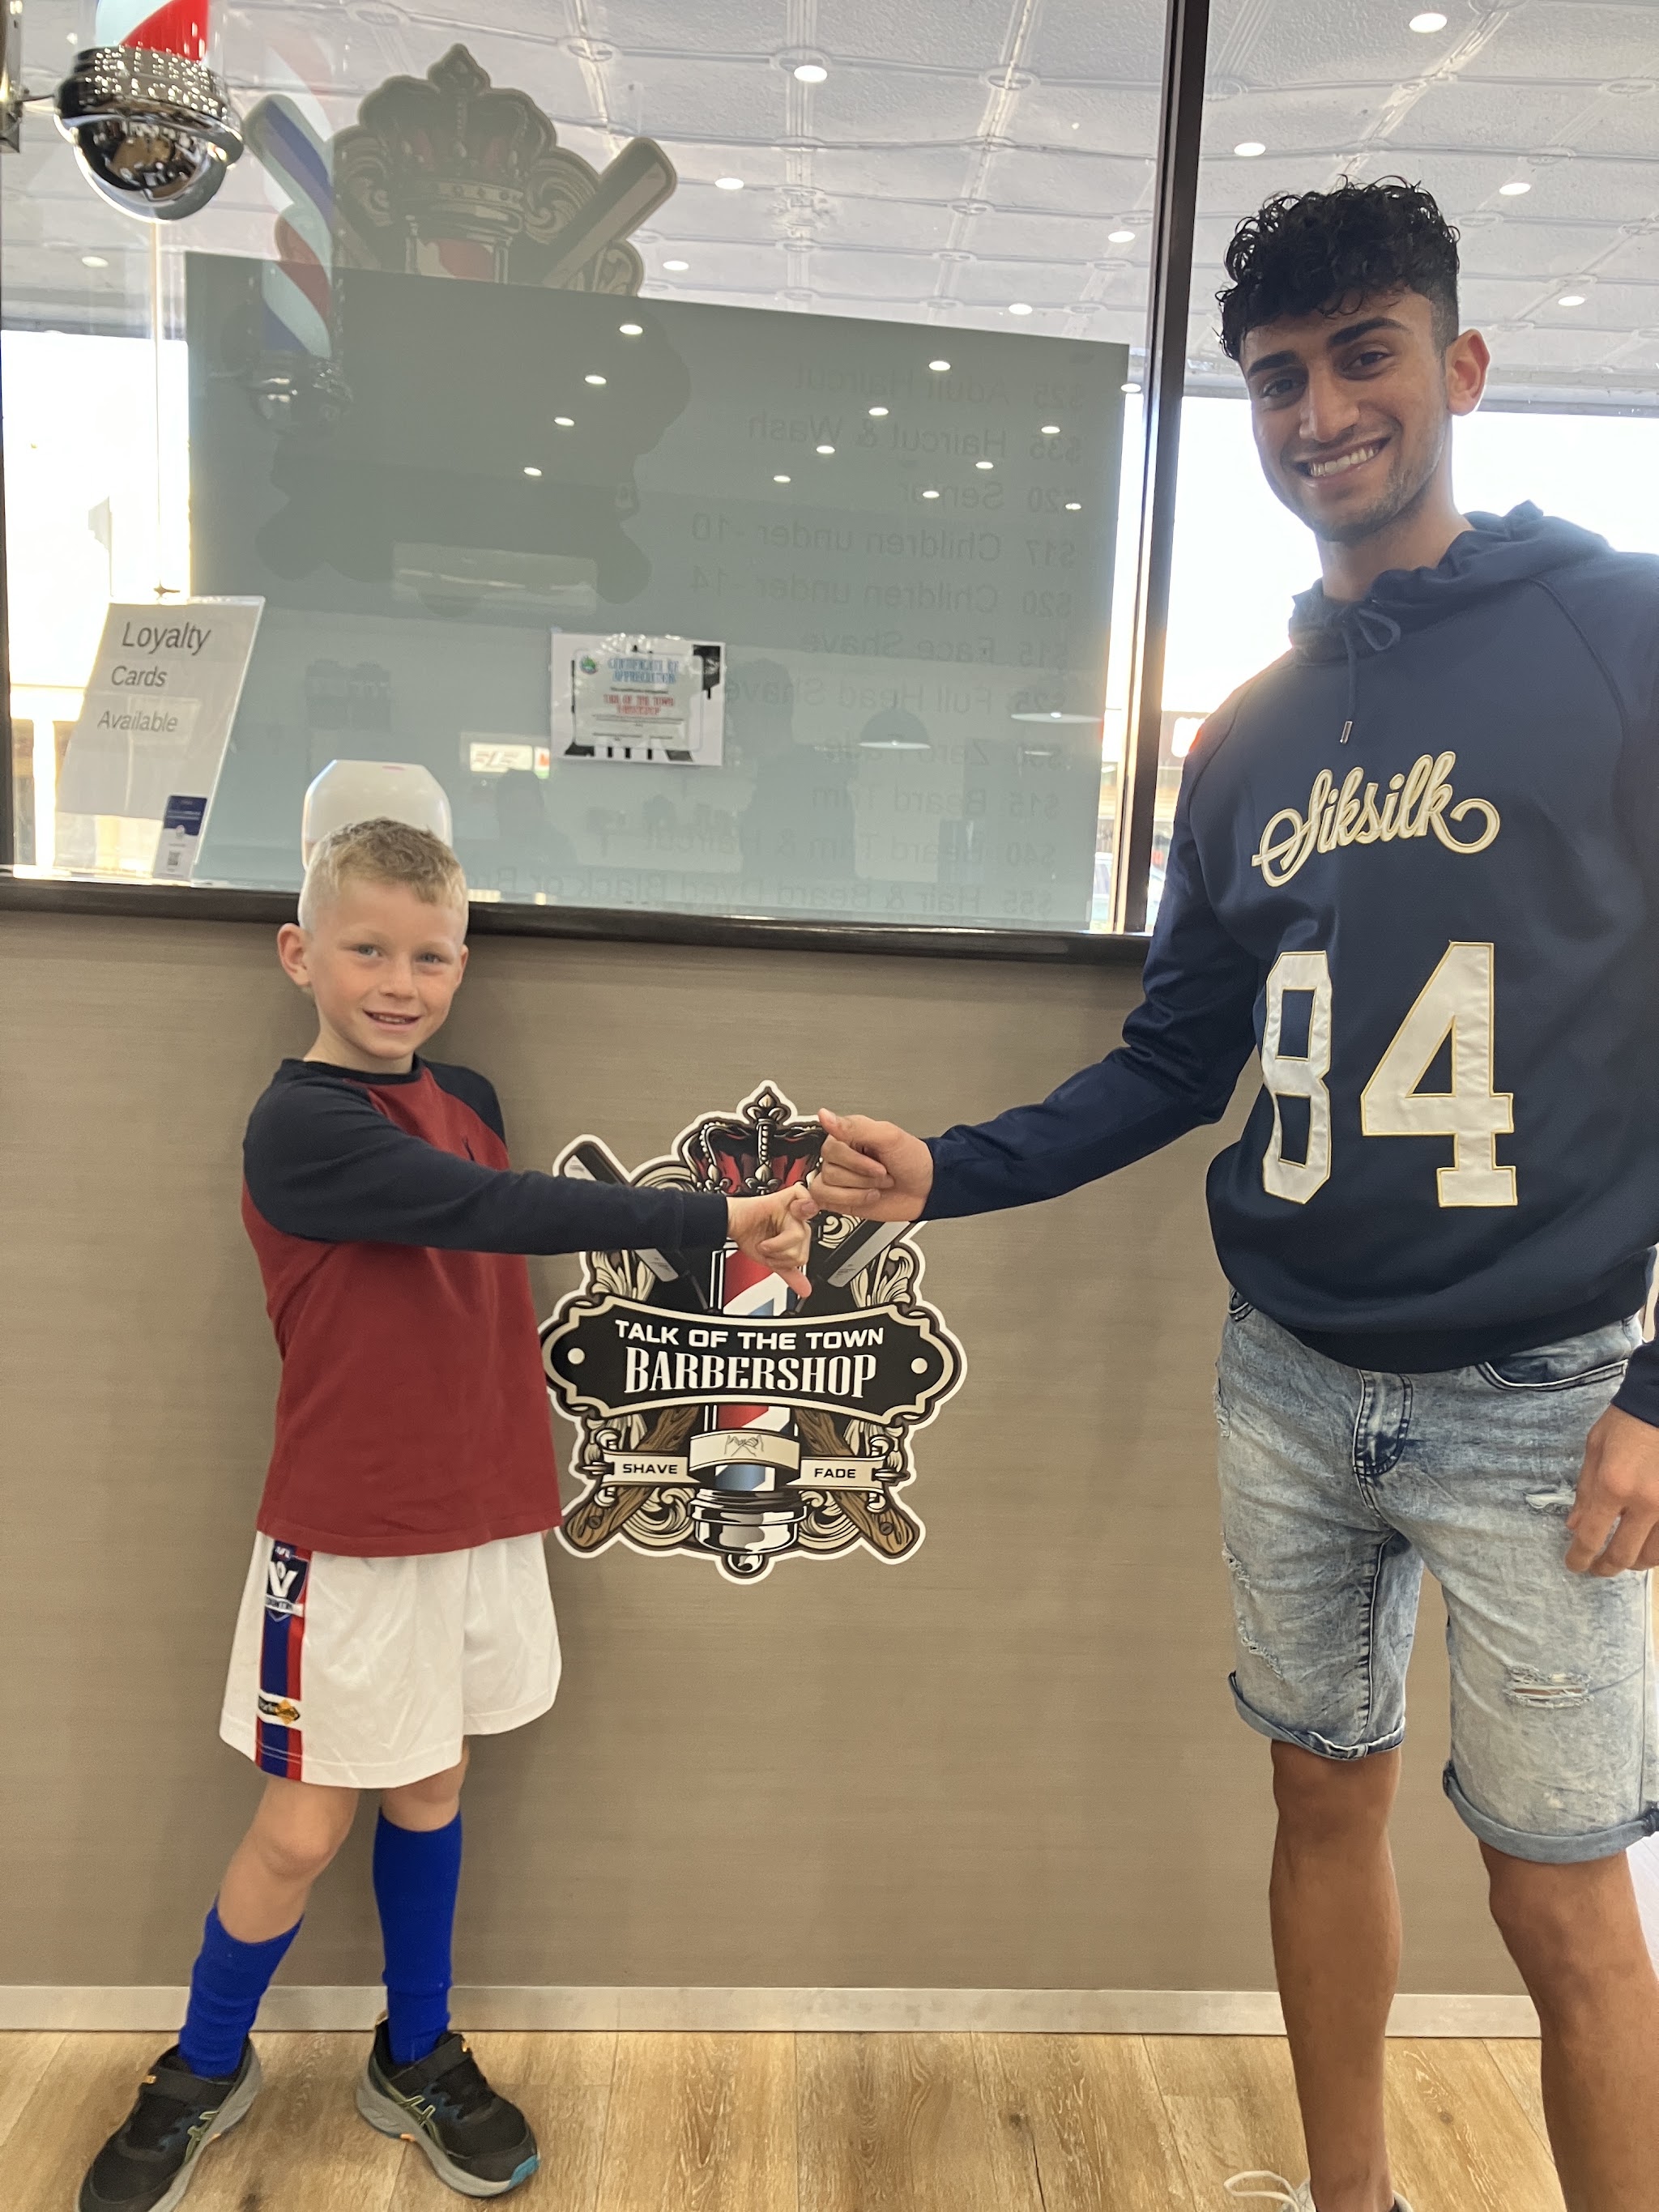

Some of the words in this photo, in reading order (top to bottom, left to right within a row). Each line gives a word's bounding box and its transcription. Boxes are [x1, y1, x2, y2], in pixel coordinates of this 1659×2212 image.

[122, 621, 211, 656] Loyalty
[111, 665, 168, 688] Cards
[97, 710, 178, 733] Available
[1261, 940, 1519, 1208] 84
[615, 1319, 680, 1346] TALK
[689, 1328, 729, 1349] OF
[737, 1332, 797, 1350] THE
[806, 1327, 885, 1350] TOWN
[623, 1345, 877, 1399] BARBERSHOP
[622, 1463, 678, 1475] SHAVE
[814, 1467, 857, 1479] FADE
